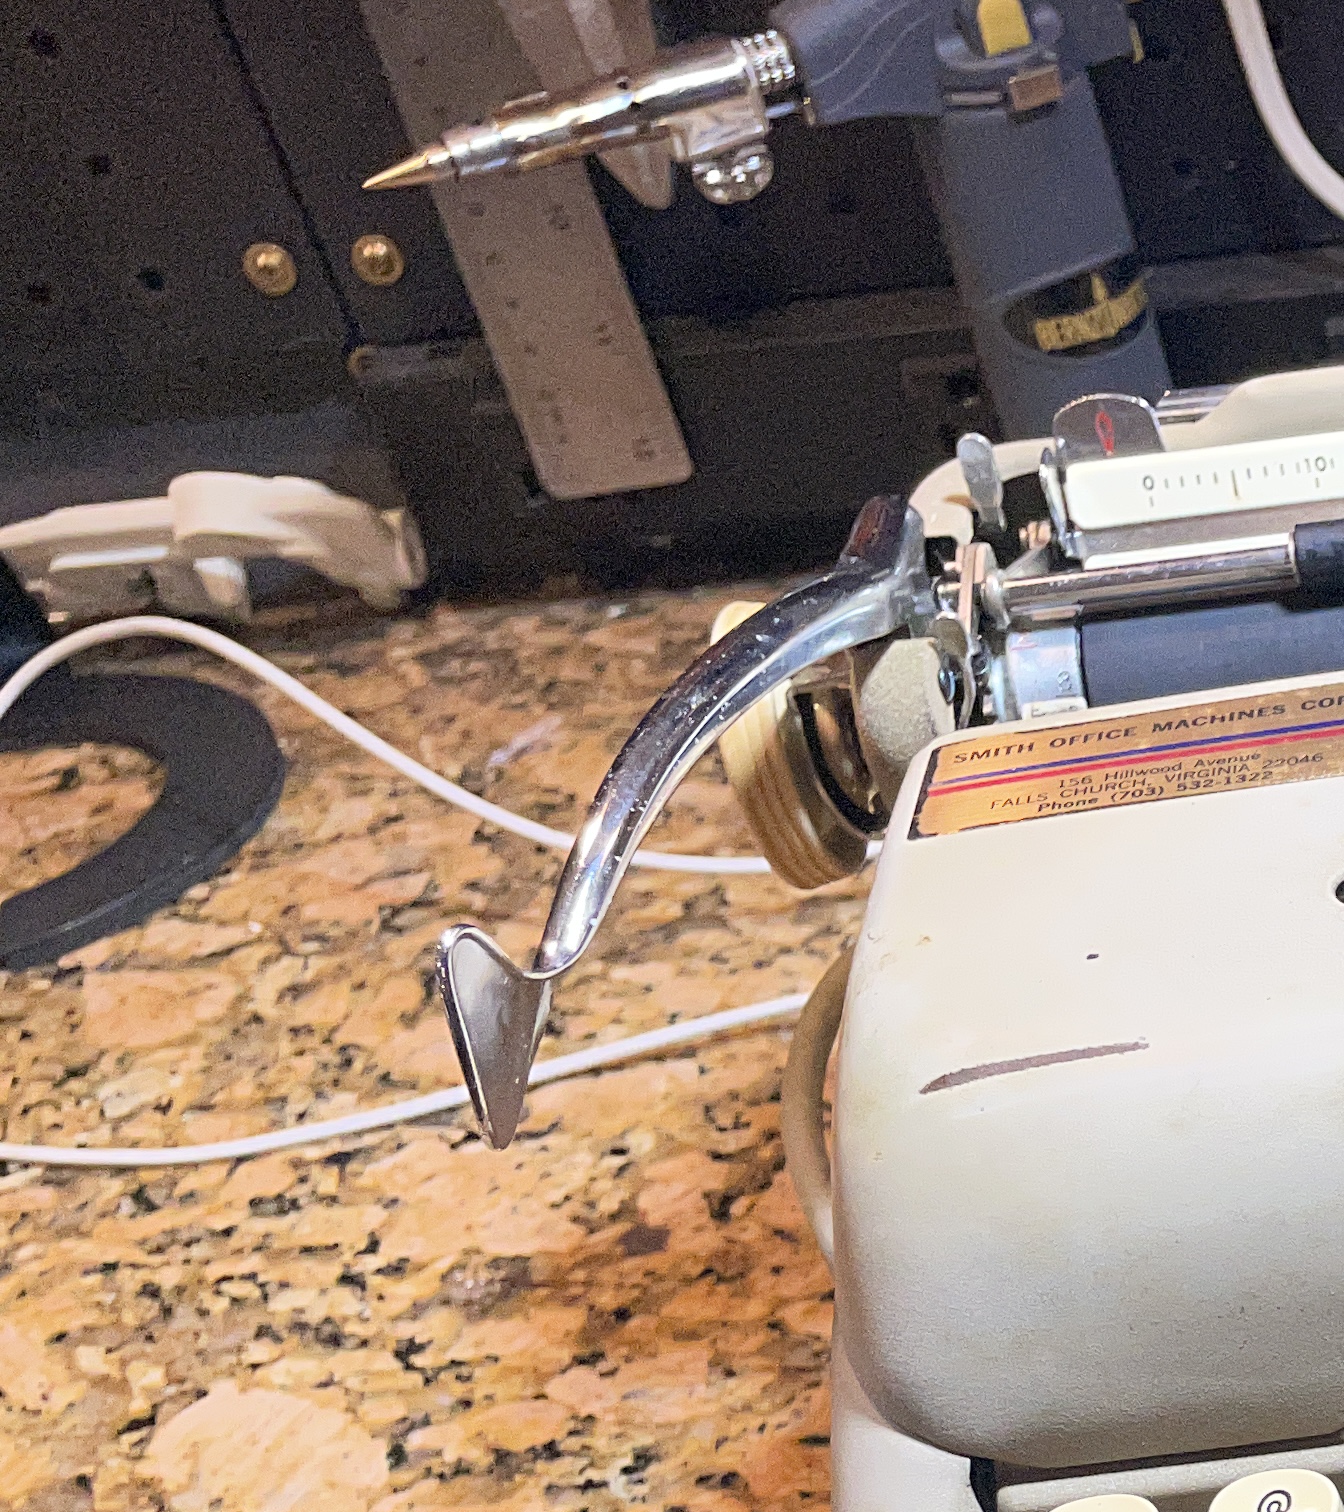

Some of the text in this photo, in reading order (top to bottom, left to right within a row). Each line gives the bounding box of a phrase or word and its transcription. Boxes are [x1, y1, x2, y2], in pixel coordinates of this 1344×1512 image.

[1305, 456, 1327, 473] 10
[954, 742, 1034, 763] SMITH
[1050, 726, 1137, 748] OFFICE
[1152, 704, 1286, 733] MACHINES
[990, 793, 1049, 809] FALLS
[1165, 764, 1251, 783] VIRGINIA
[1262, 752, 1324, 769] 22046
[1059, 751, 1262, 788] 156 Hillwood Avenue
[1037, 771, 1274, 812] Phone (703) 532-1322
